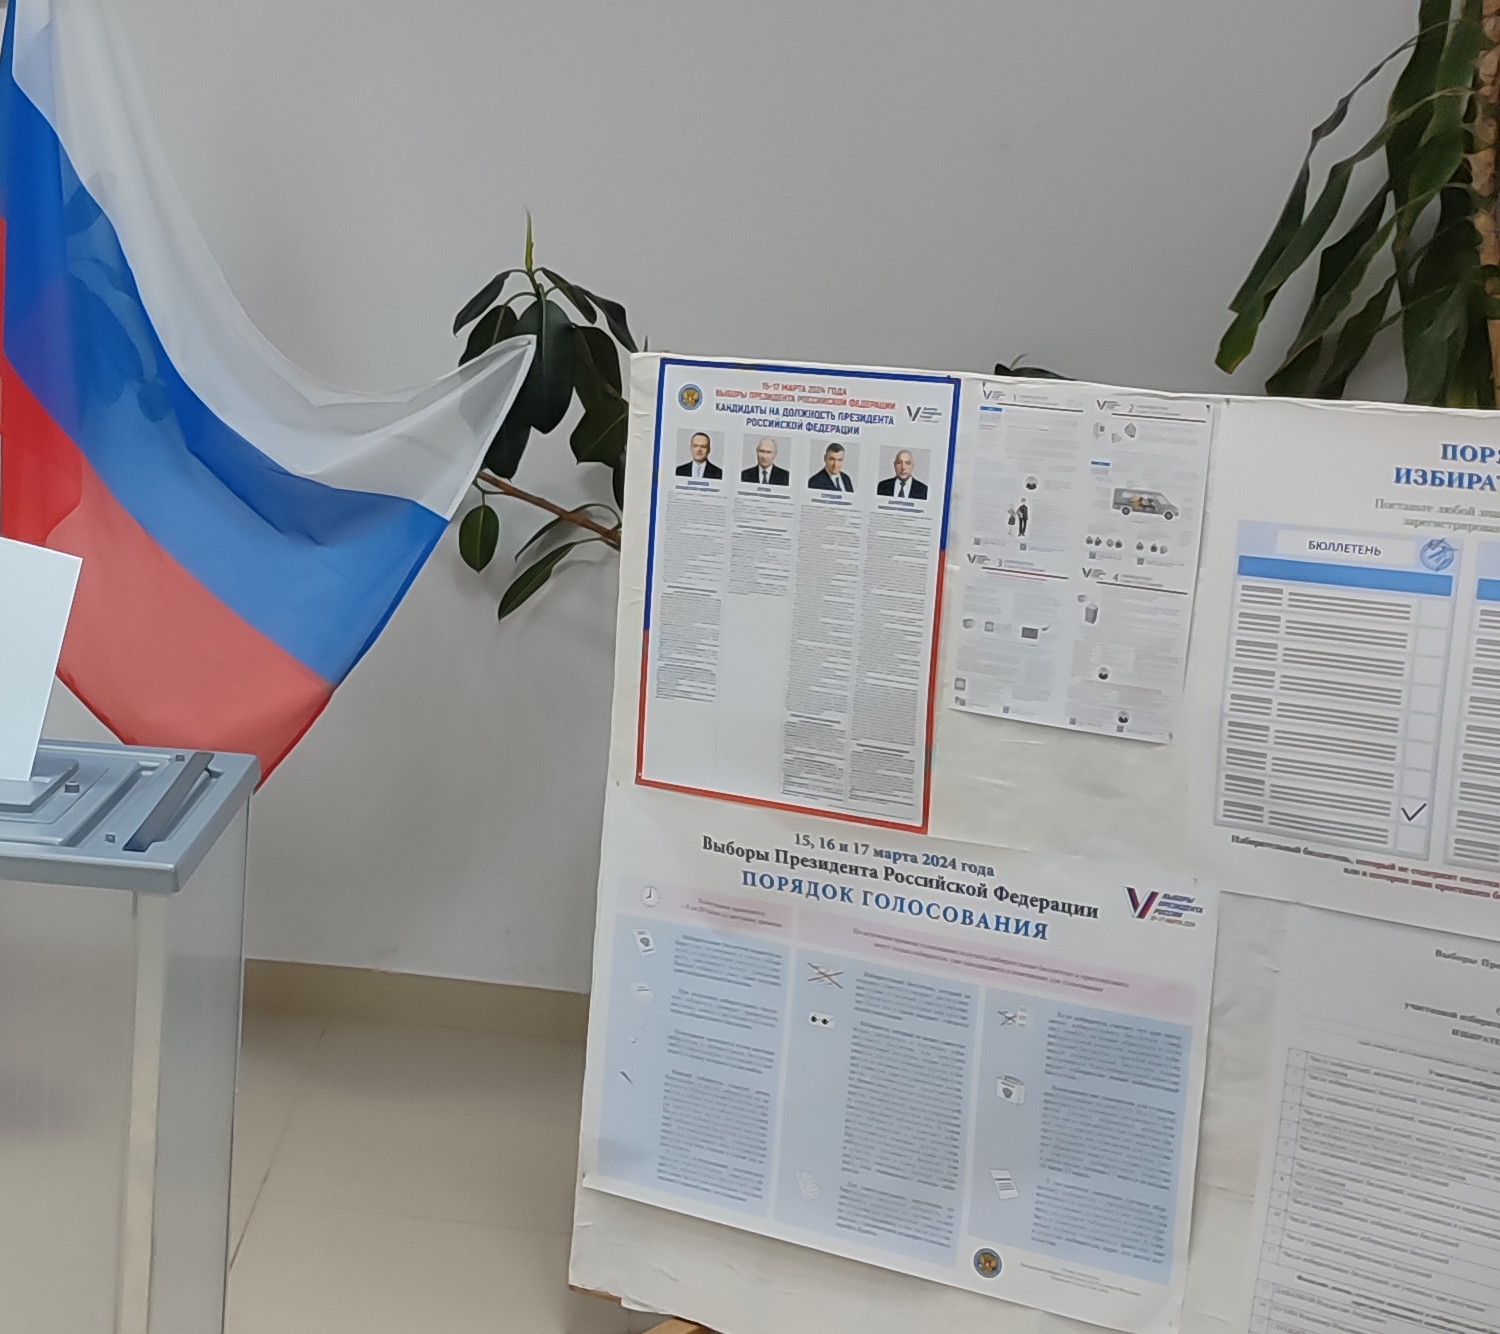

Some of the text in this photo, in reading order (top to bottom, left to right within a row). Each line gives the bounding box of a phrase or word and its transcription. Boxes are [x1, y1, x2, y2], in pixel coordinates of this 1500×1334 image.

[827, 387, 847, 396] ГОДА
[715, 403, 895, 425] КАНДИДАТЫ НА ДОЛЖНОСТЬ ПРЕЗИДЕНТА
[746, 418, 860, 435] РОССИЙСКОЙ ФЕДЕРАЦИИ
[1308, 540, 1382, 556] БЮЛЛЕТЕНЬ
[794, 833, 996, 877] 15, 16 и 17 марта 2024 года
[702, 835, 1099, 919] Выборы Президента Российской Федерации
[741, 870, 1048, 940] ПОРЯДОК ГОЛОСОВАНИЯ
